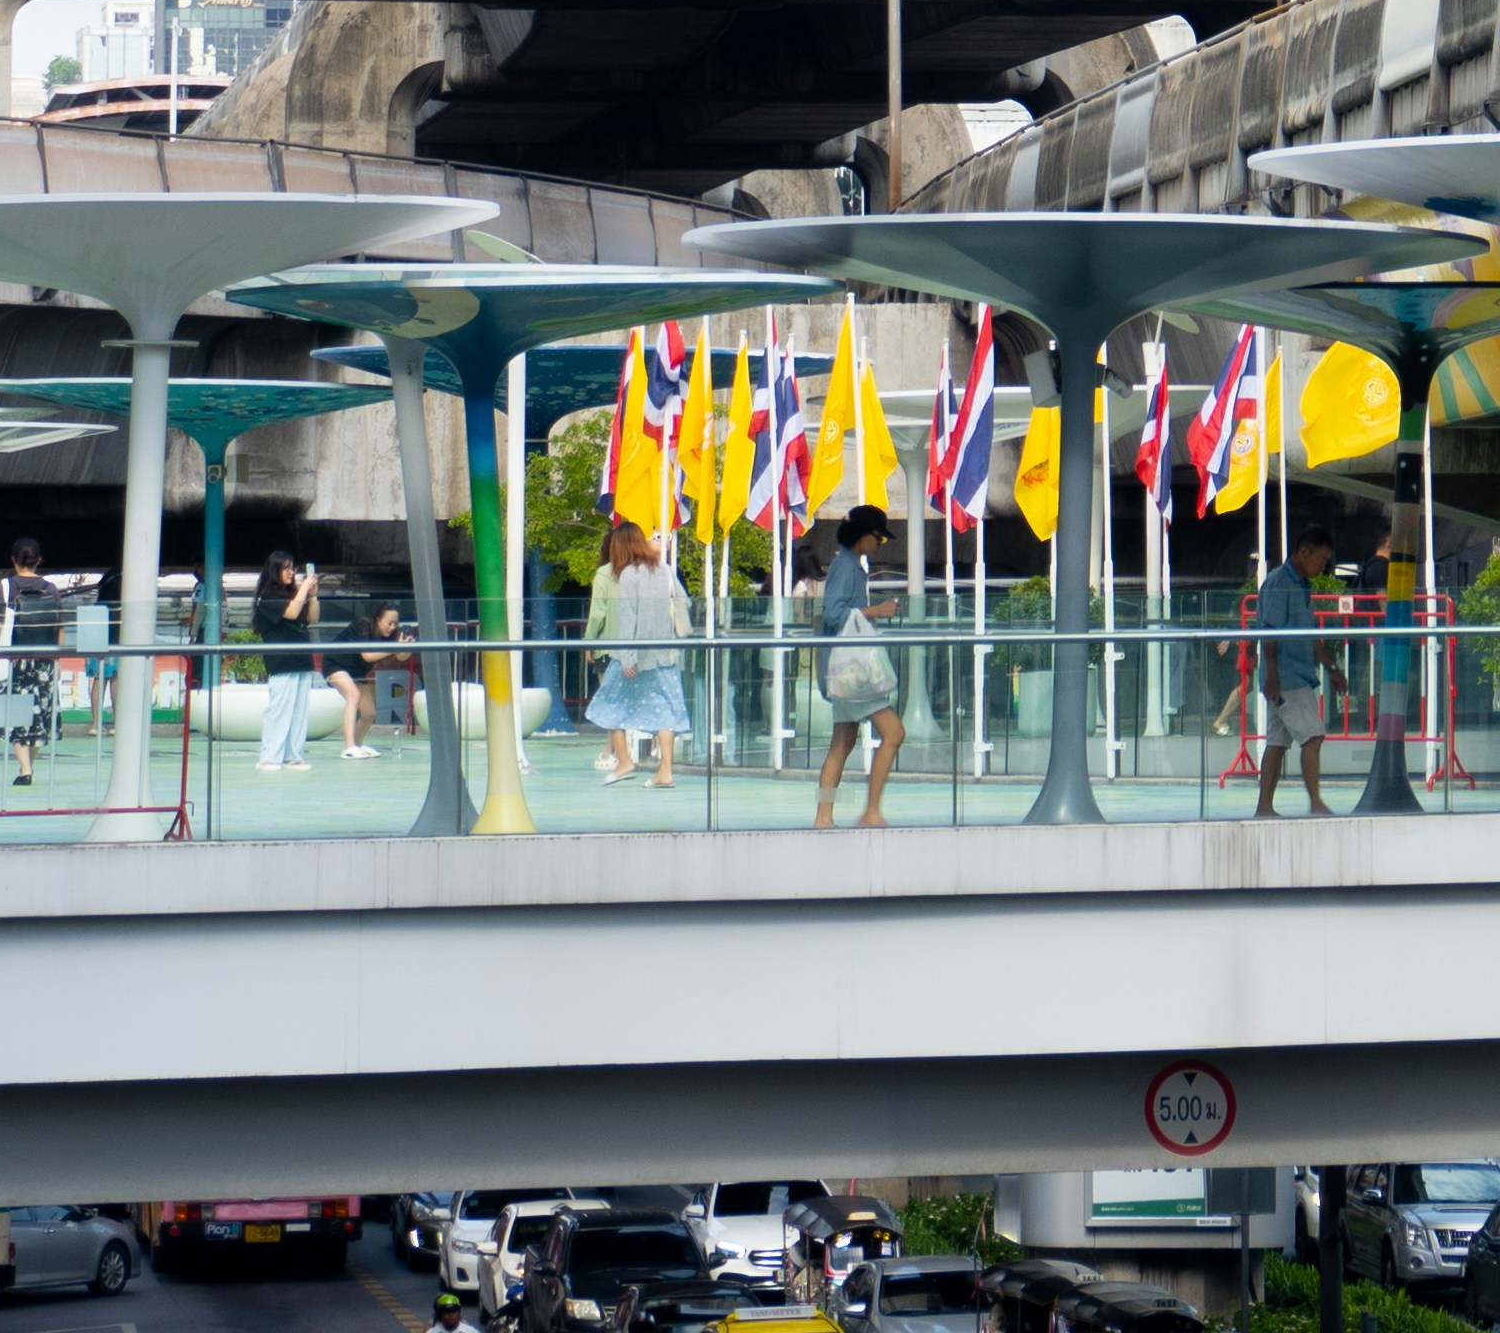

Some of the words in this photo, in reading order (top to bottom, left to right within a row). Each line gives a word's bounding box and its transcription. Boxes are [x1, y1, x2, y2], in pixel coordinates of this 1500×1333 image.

[1160, 1096, 1202, 1121] 5.00
[1206, 1102, 1221, 1120] ม.
[1156, 1299, 1177, 1307] TAXI
